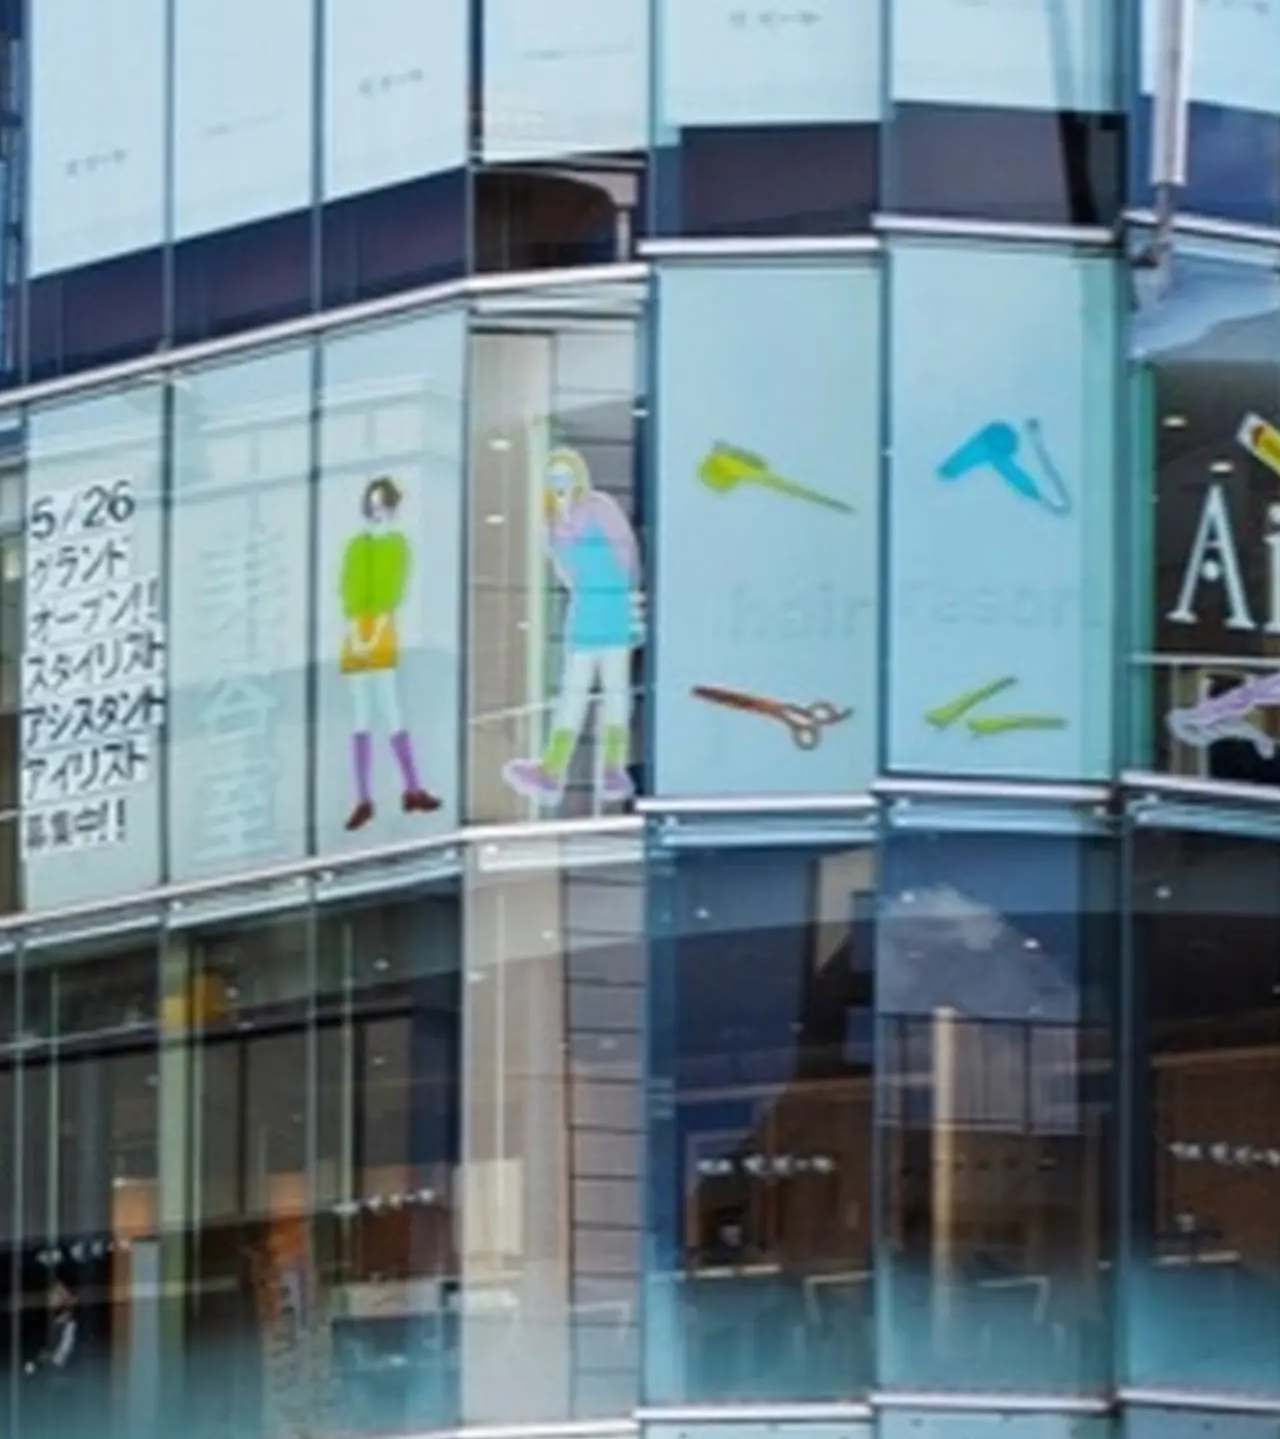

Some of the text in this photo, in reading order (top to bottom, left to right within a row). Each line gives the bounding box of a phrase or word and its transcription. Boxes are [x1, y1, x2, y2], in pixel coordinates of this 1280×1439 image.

[30, 479, 136, 540] 5/26
[30, 535, 131, 592] グランド
[25, 627, 166, 695] スタイリスト
[23, 684, 167, 748] アシスタント
[24, 741, 149, 801] アイリスト
